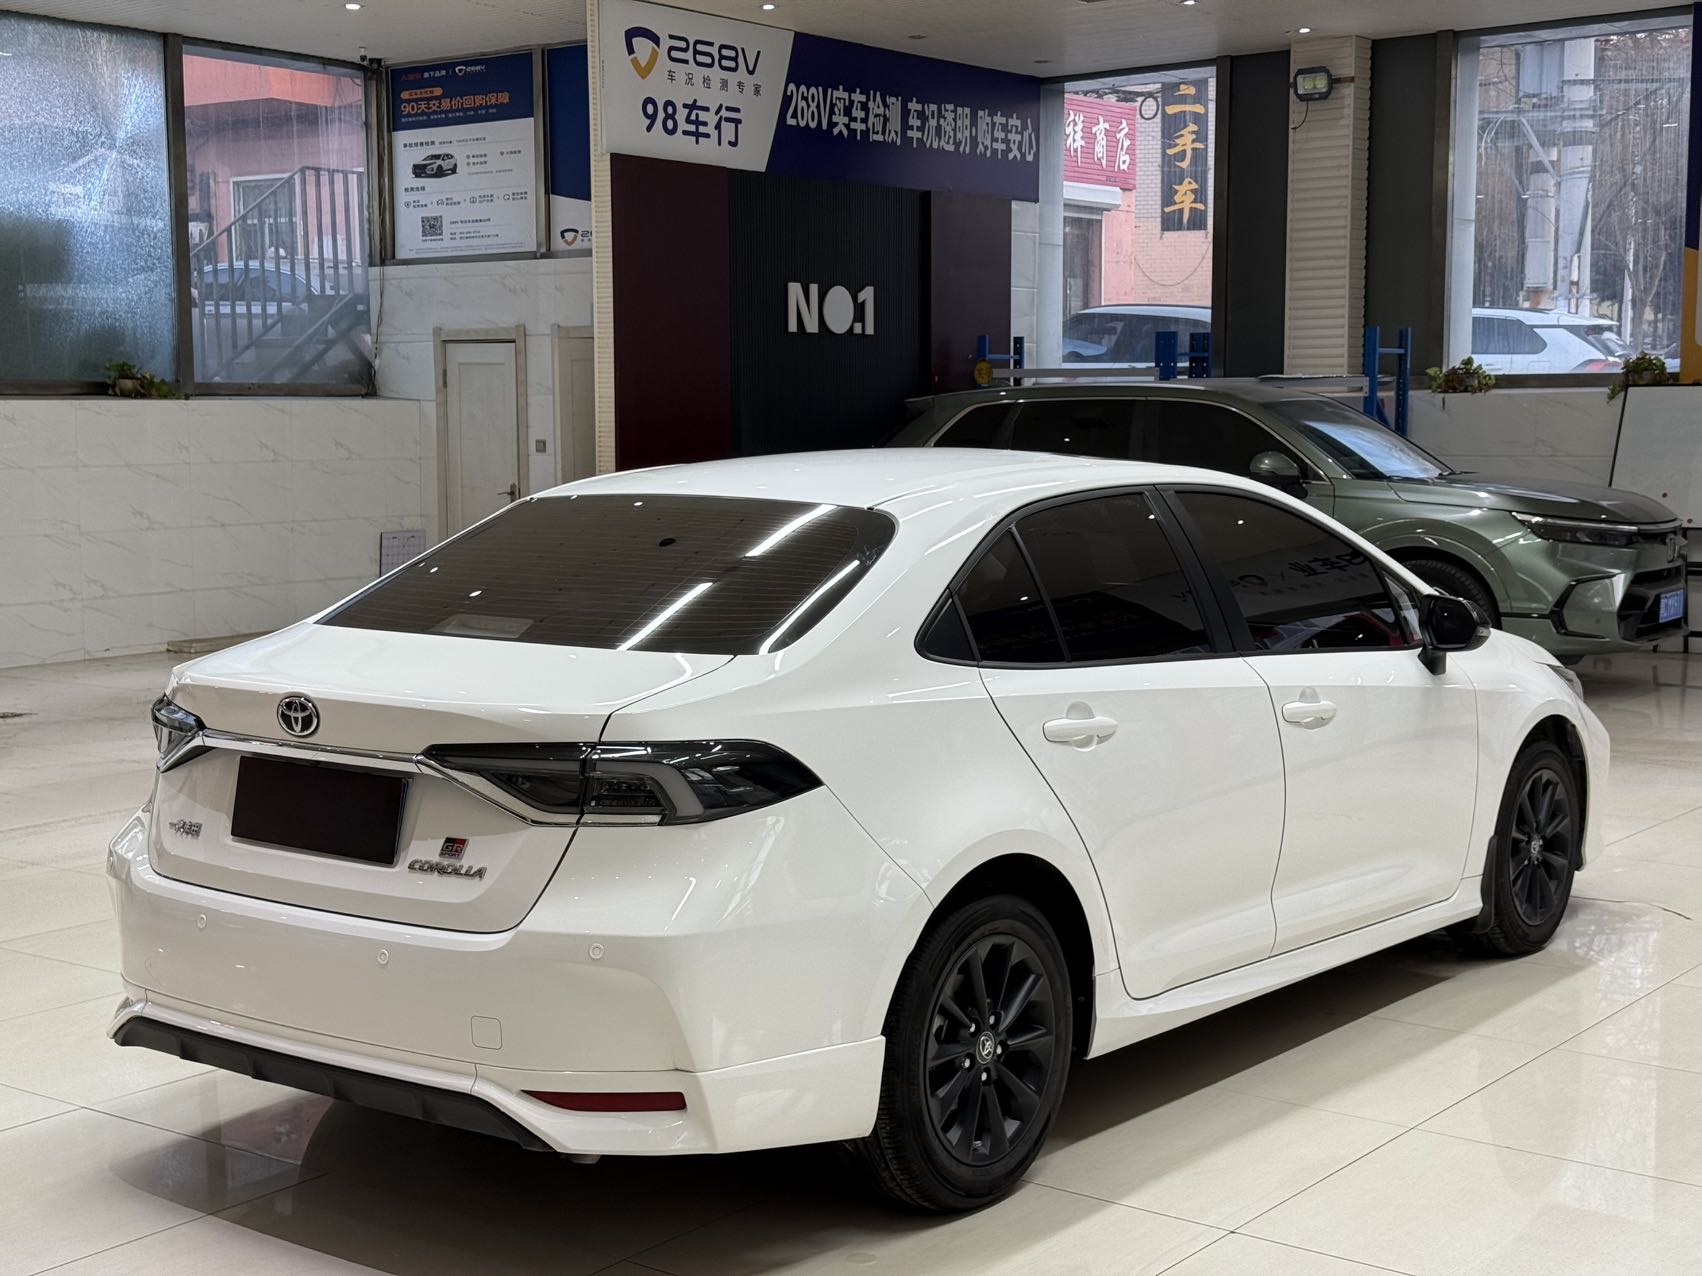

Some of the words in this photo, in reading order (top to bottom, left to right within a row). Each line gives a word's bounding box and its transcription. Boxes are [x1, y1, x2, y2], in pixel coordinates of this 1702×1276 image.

[667, 34, 761, 75] 268V
[667, 69, 762, 97] 车况检测专家
[642, 96, 743, 148] 98车行
[786, 83, 902, 146] 268V实车检测
[1163, 83, 1206, 225] 二手车
[787, 282, 875, 335] NO.1
[408, 858, 488, 881] COROLLA
[442, 842, 463, 853] GR
